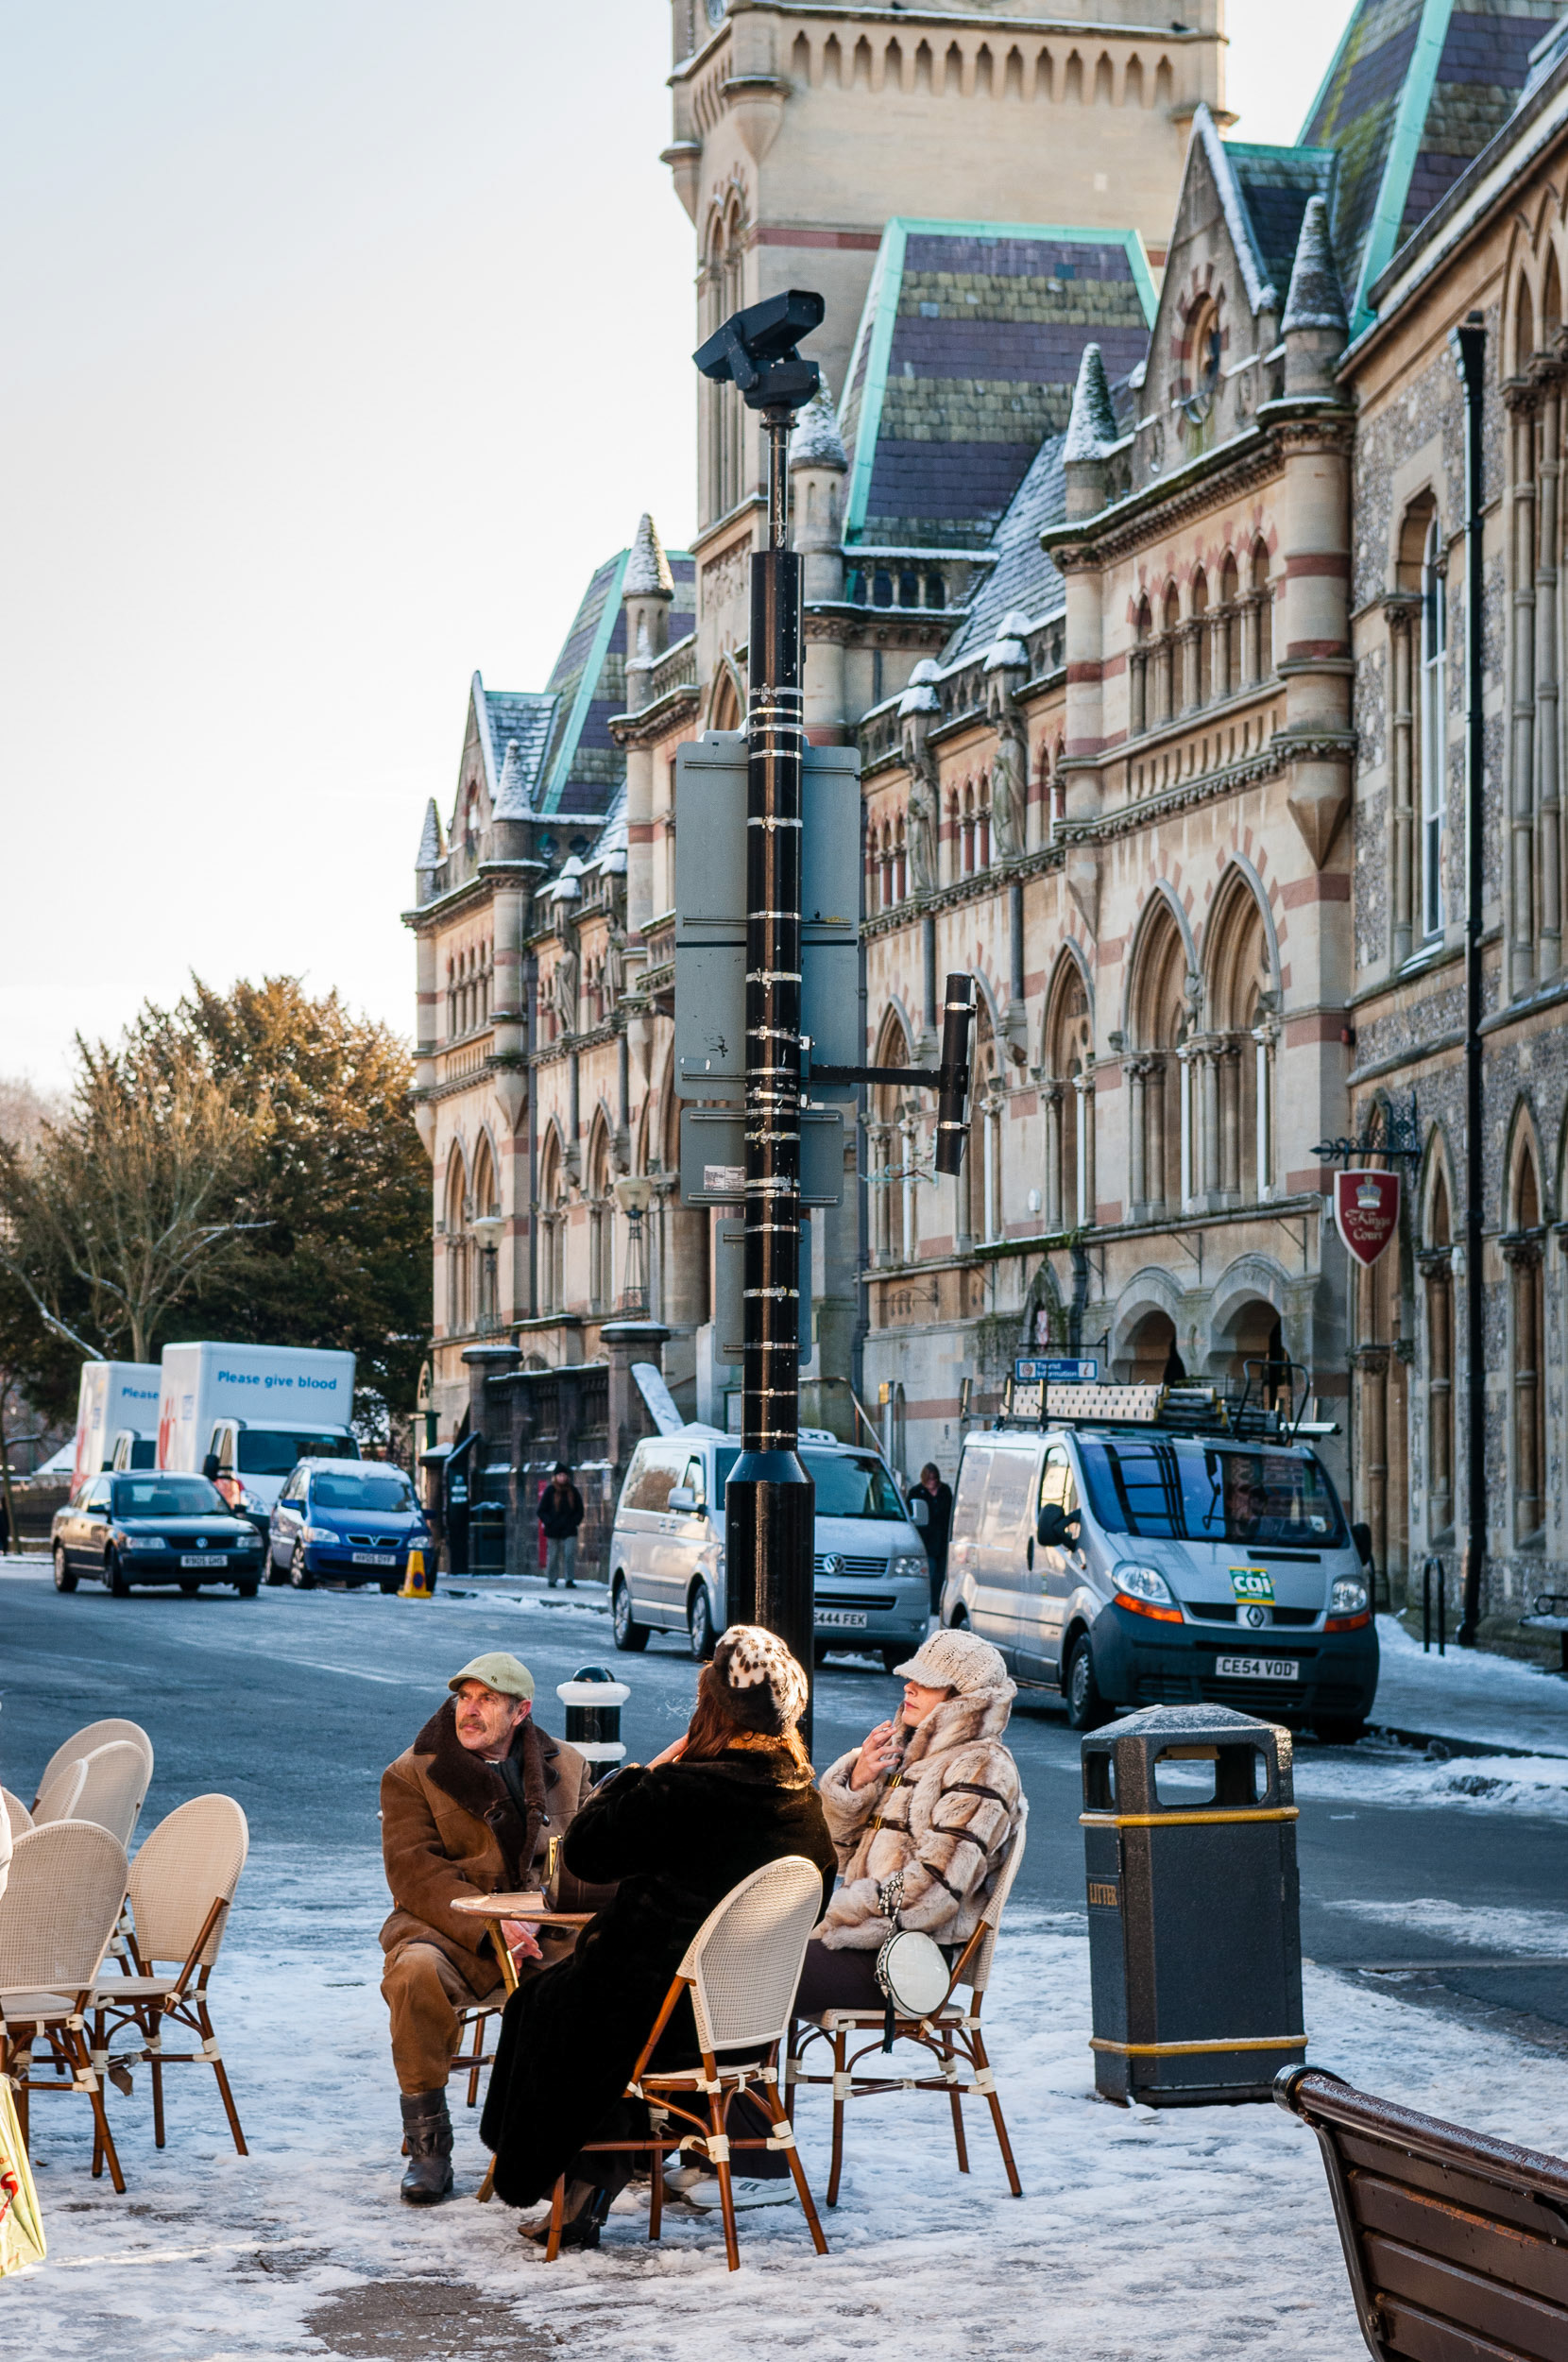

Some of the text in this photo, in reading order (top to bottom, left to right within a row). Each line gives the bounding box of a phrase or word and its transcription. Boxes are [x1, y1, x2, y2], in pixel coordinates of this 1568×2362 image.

[1353, 1227, 1383, 1241] Court
[217, 1370, 337, 1391] Please give blood
[122, 1386, 159, 1399] Please
[843, 1613, 864, 1625] FEK
[1222, 1658, 1292, 1676] CE54 VOD
[1089, 1883, 1117, 1905] LITTER
